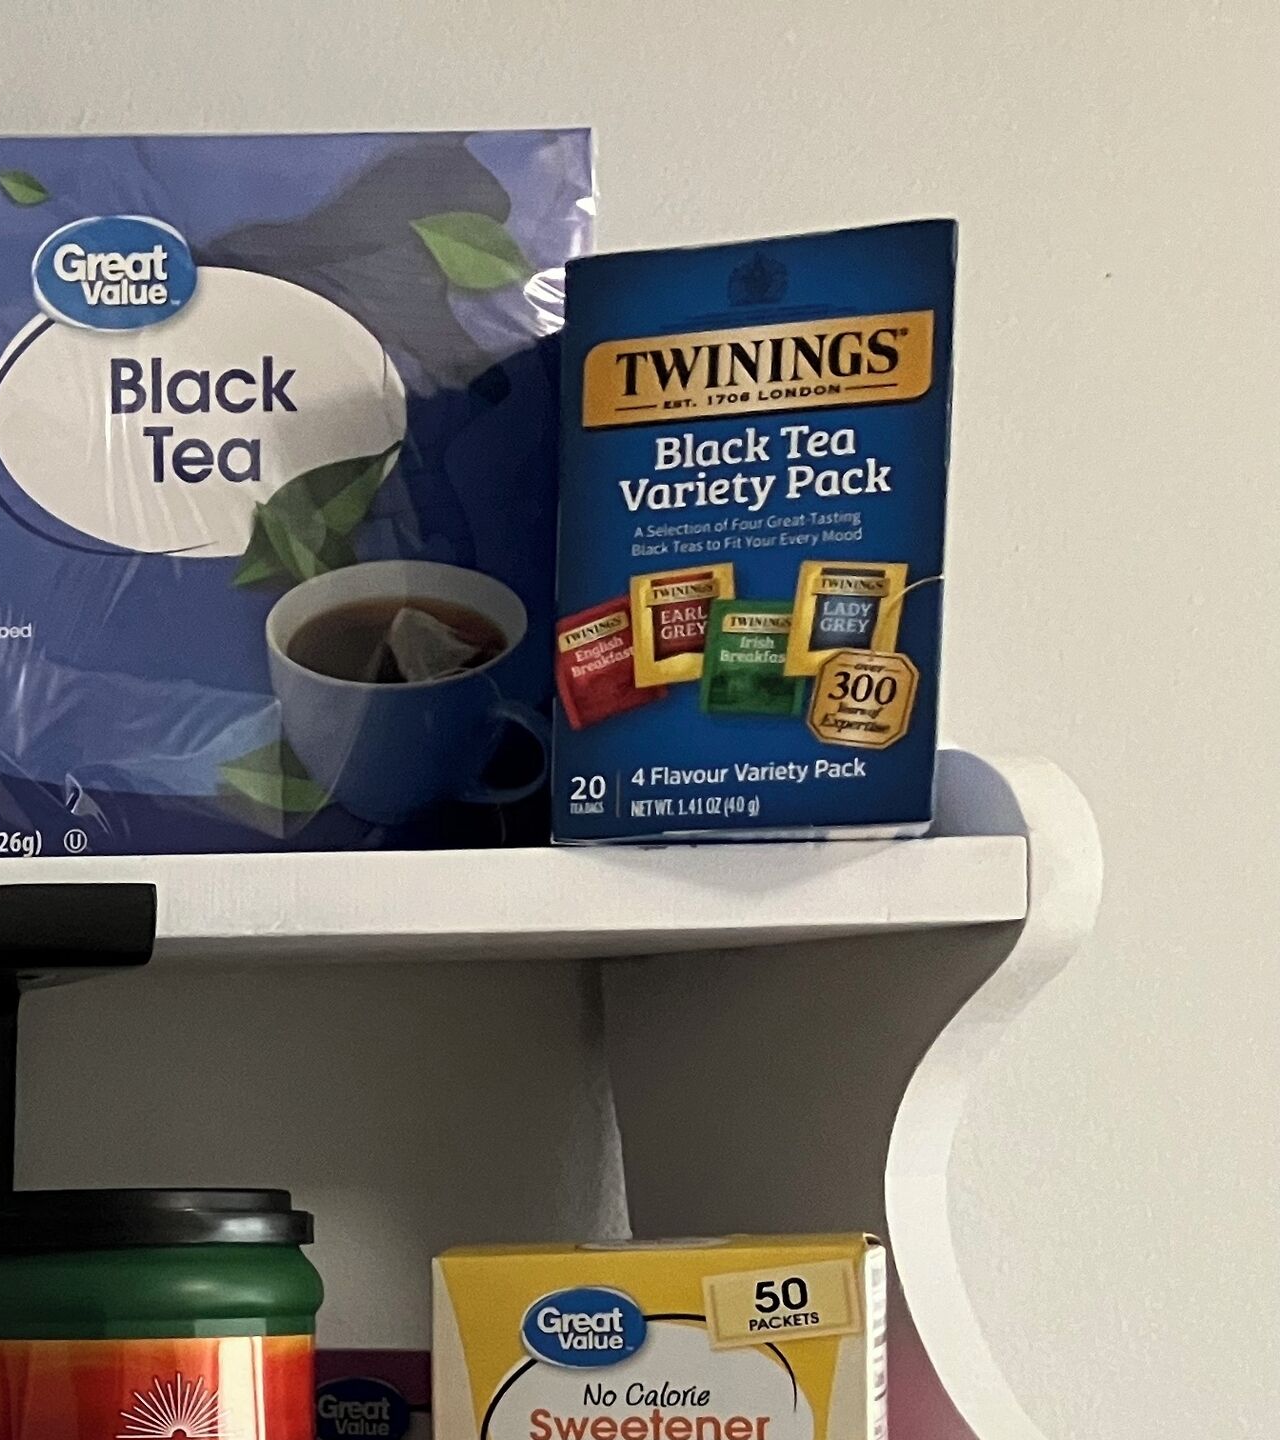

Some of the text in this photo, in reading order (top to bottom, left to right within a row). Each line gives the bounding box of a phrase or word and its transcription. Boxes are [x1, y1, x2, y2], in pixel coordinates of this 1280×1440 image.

[53, 243, 168, 282] Great
[81, 278, 168, 306] Value
[616, 328, 901, 396] TWININGS
[111, 356, 298, 414] Black
[663, 399, 697, 409] EST.
[758, 384, 841, 401] LONDON
[143, 426, 262, 484] Tea
[654, 425, 856, 471] Black Tea
[618, 458, 892, 512] Variety Pack
[634, 526, 644, 538] A
[646, 519, 710, 539] Selection
[714, 518, 729, 534] of
[732, 515, 764, 532] Four
[632, 528, 863, 557] Black Teas to Fit Your Every Mood
[653, 582, 713, 600] TWININGS
[661, 606, 708, 625] EARL
[824, 602, 873, 617] LADY
[565, 616, 622, 645] TWININGS
[661, 621, 708, 640] GREY
[820, 617, 870, 633] GREY
[575, 636, 624, 663] English
[739, 636, 774, 649] Irish
[828, 671, 897, 705] 300
[632, 757, 867, 786] 4 Flavour Variety Pack
[571, 776, 606, 800] 20
[631, 800, 652, 817] NET
[679, 797, 703, 816] 1.41
[706, 796, 722, 815] OZ
[755, 1277, 808, 1313] 50
[537, 1306, 624, 1334] Great
[749, 1312, 820, 1331] PACKETS
[558, 1331, 624, 1350] Value
[318, 1394, 390, 1420] Great
[583, 1381, 710, 1408] No Calorie
[335, 1420, 389, 1436] Value
